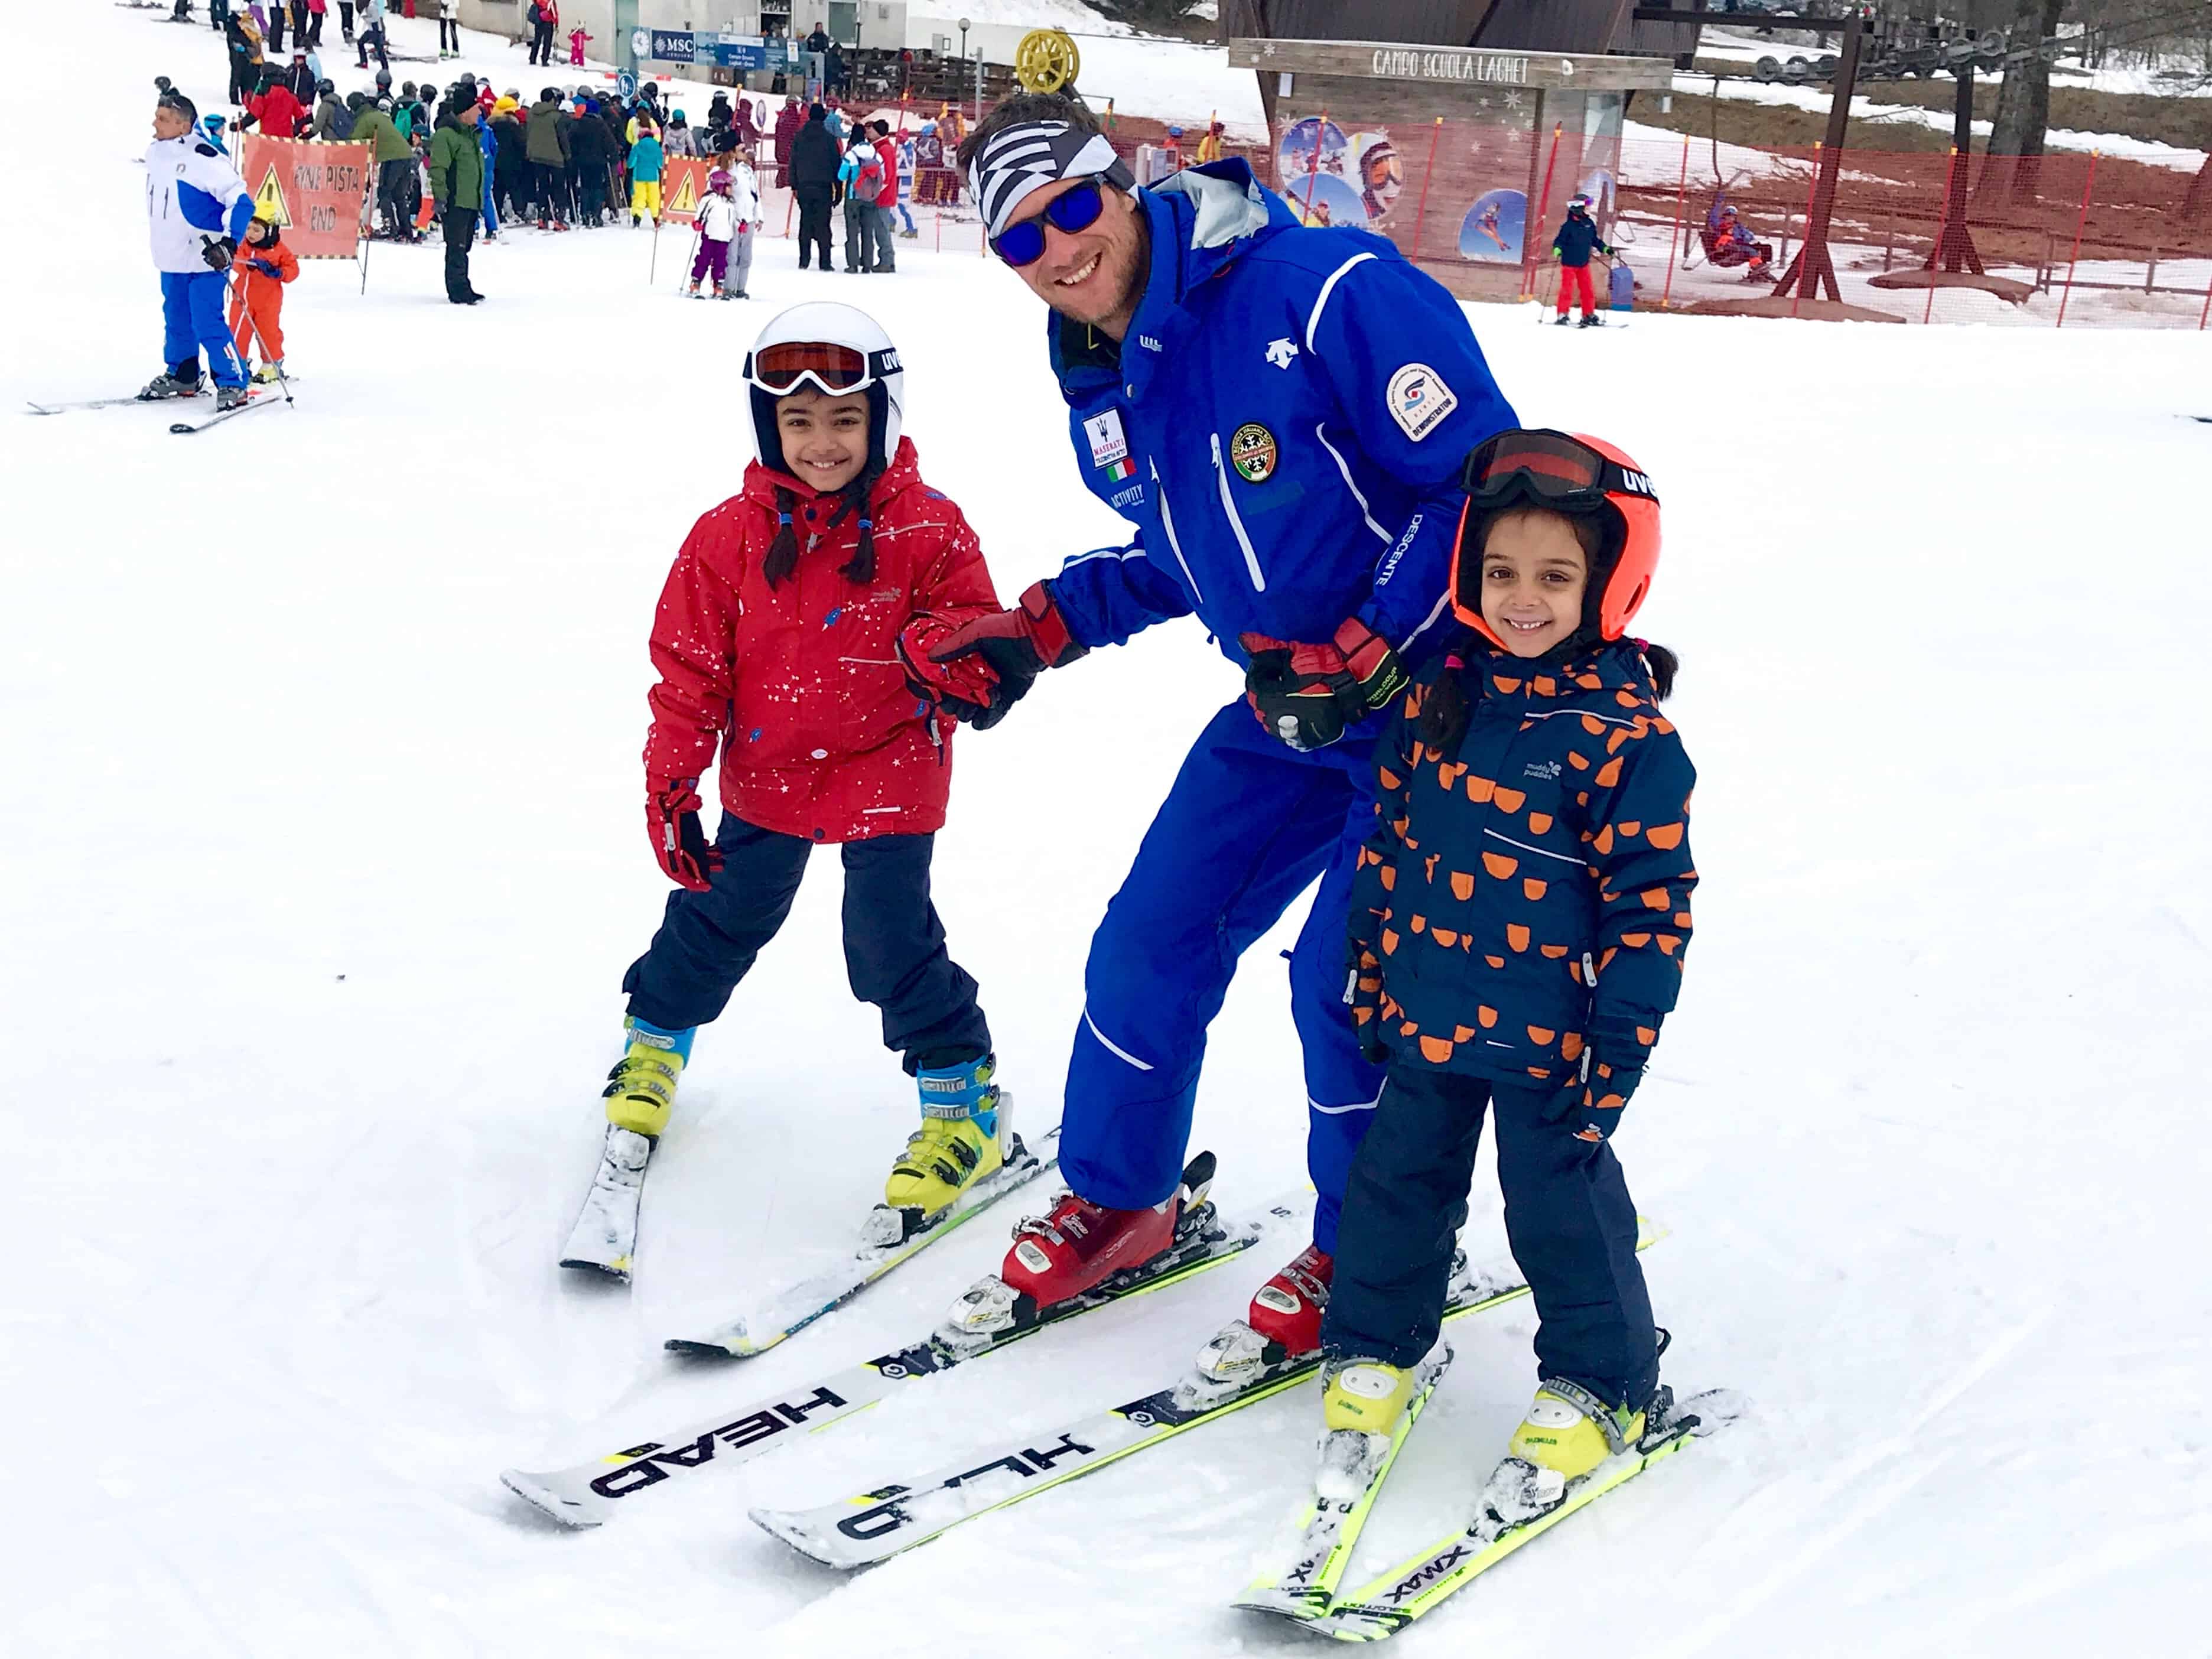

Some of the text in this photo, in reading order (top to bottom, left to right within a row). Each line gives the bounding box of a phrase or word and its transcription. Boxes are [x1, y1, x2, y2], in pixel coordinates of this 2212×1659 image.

[667, 38, 693, 52] MSC
[1372, 50, 1529, 84] CAMPO SCUOLA LAGHET
[326, 165, 359, 192] PISTA
[311, 205, 336, 232] END
[1413, 398, 1453, 437] DEMONSTRATOR
[1094, 438, 1124, 456] MASERATI
[1375, 514, 1423, 586] DESCENTE
[590, 1386, 849, 1499] HEAD
[1381, 1545, 1475, 1605] XMAX
